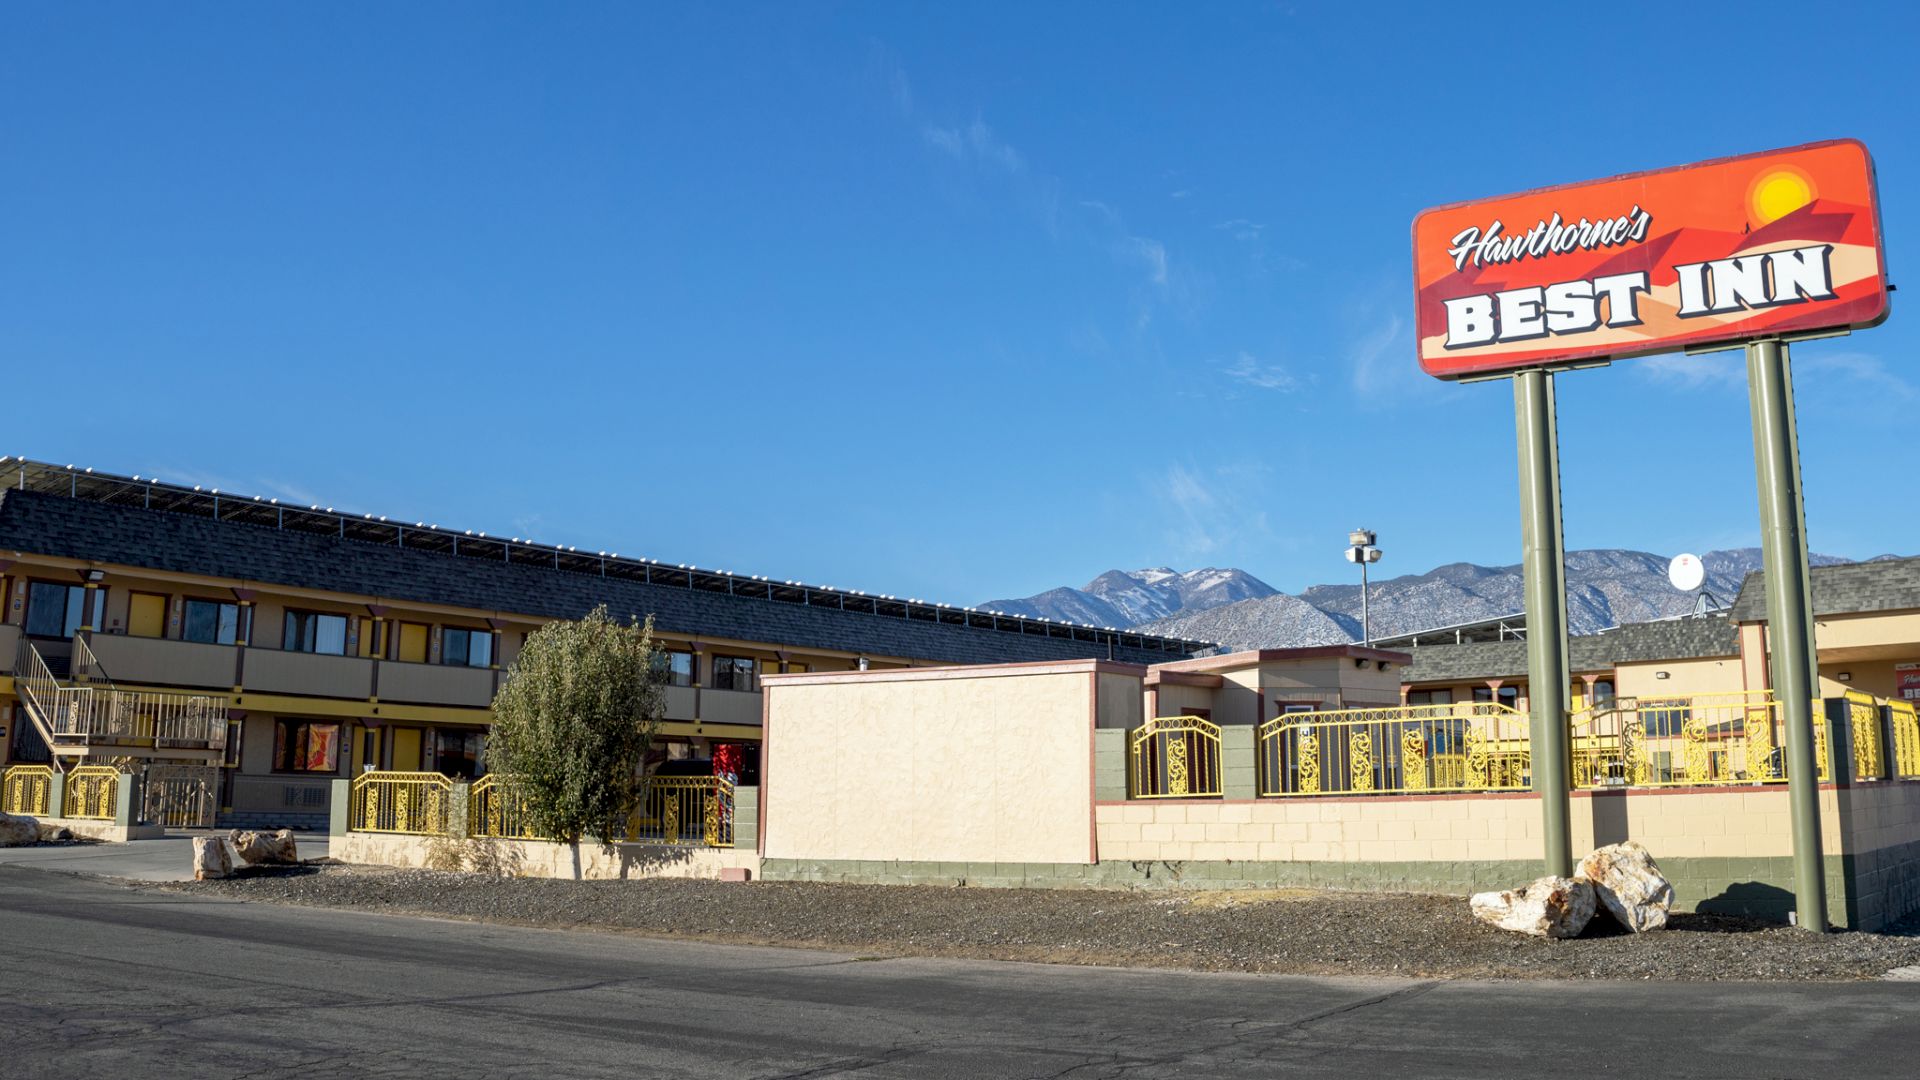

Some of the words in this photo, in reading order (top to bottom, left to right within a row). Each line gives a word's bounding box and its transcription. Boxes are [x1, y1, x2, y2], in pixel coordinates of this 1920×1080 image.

[1448, 204, 1652, 272] Hawthorne's
[1442, 271, 1651, 350] BEST
[1672, 244, 1839, 319] INN
